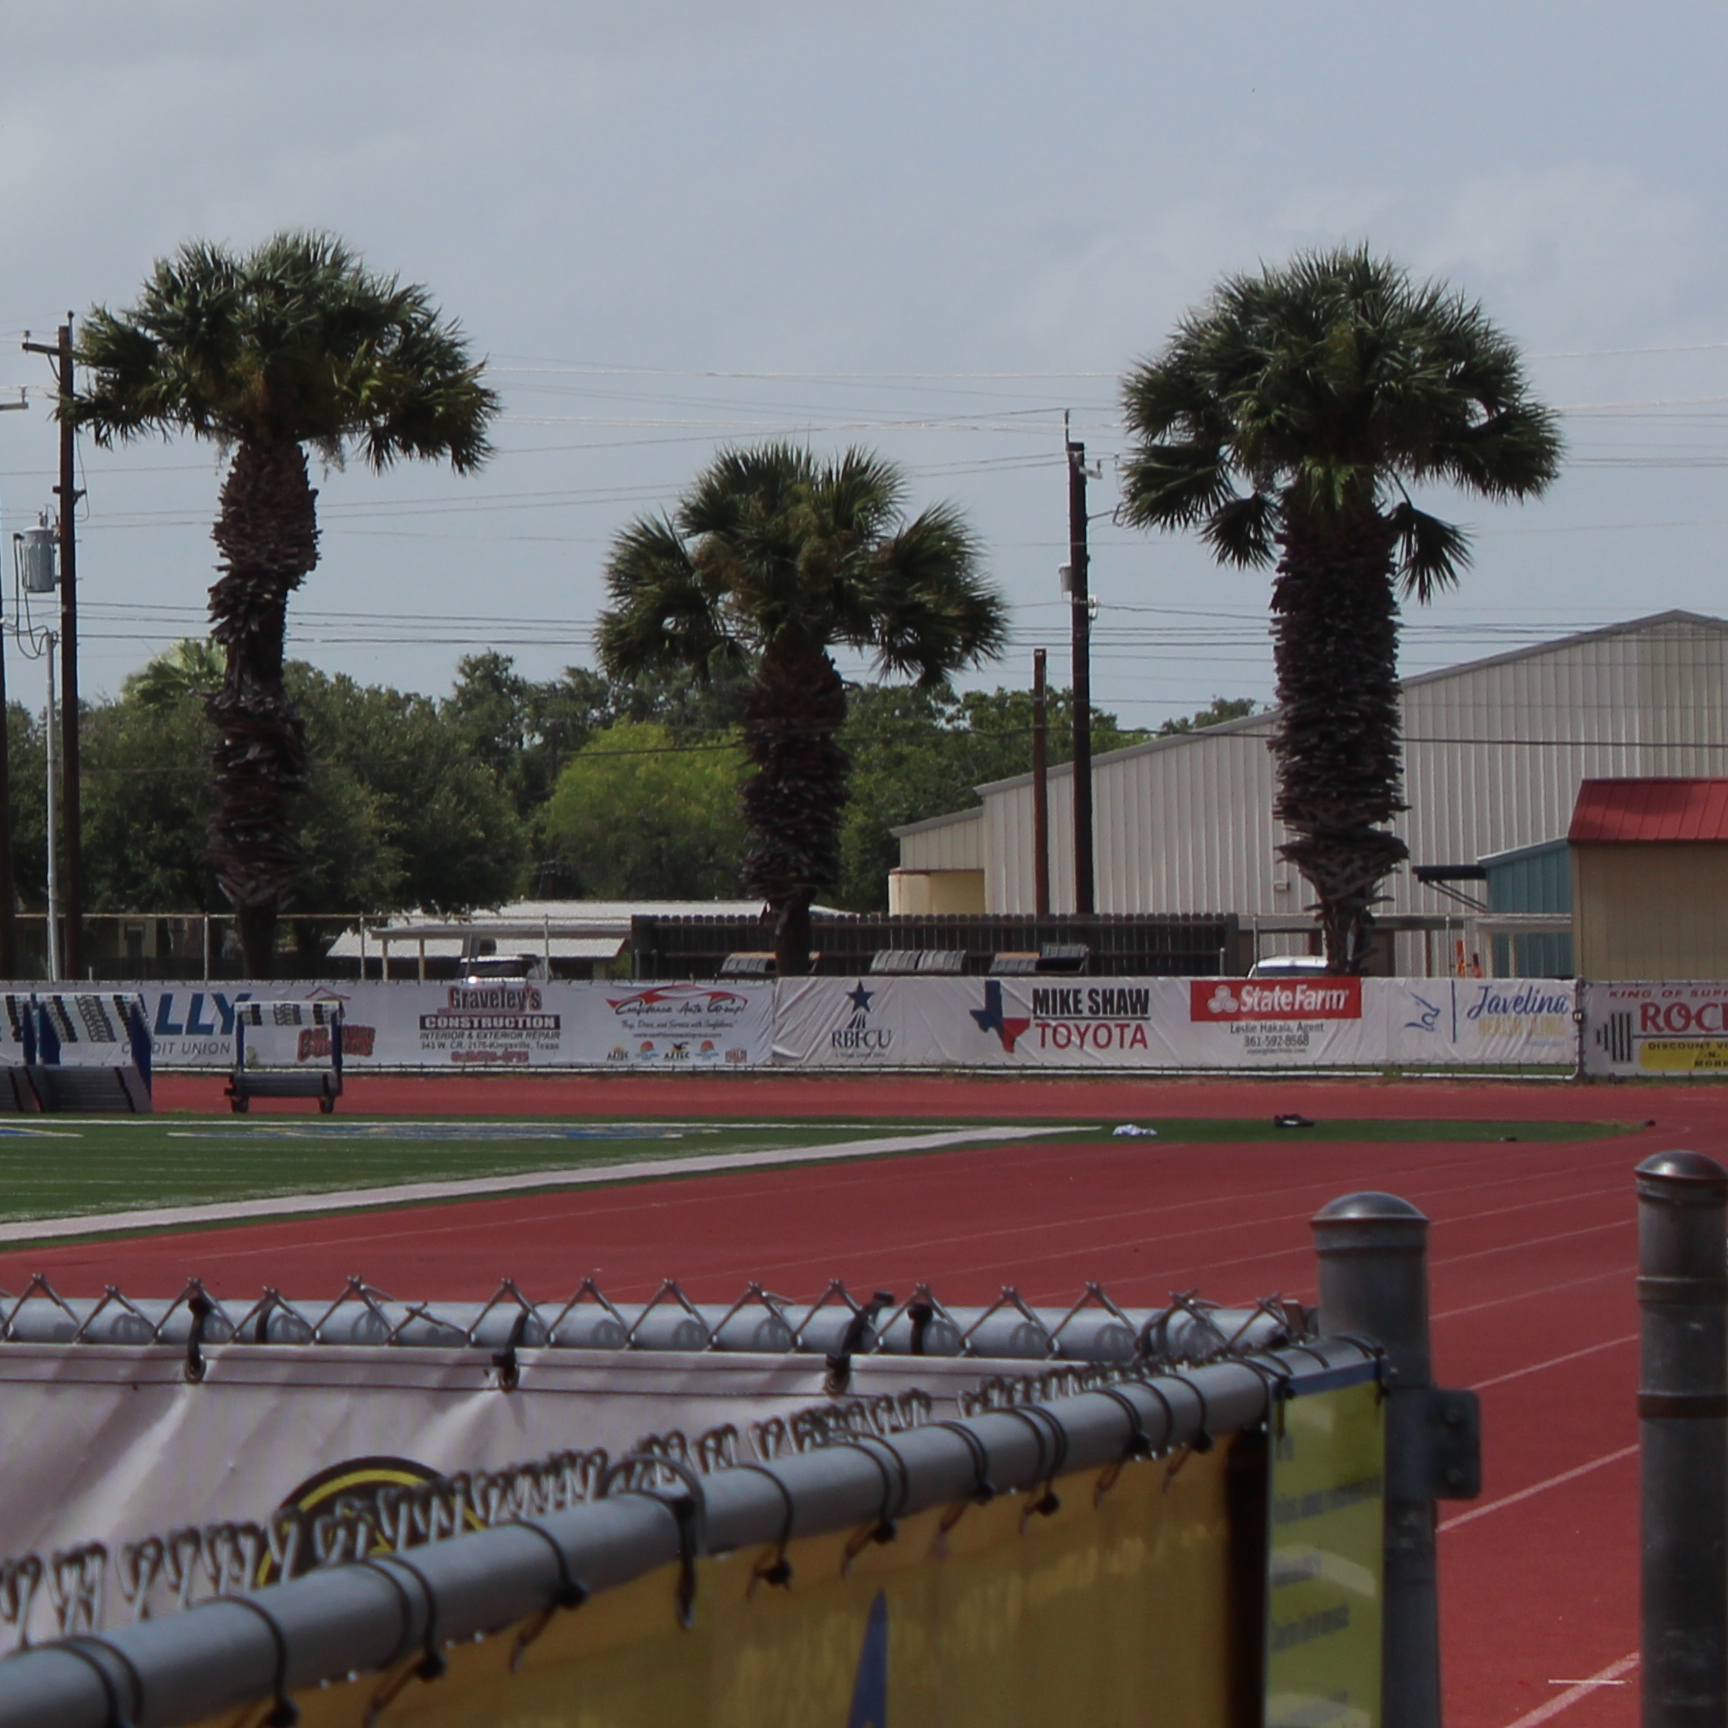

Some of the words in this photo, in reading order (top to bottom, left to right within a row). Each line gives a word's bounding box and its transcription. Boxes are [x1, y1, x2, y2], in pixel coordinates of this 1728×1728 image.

[449, 986, 542, 1011] Graveley's
[1609, 989, 1652, 999] KING
[1661, 989, 1682, 998] OF
[1032, 987, 1083, 1016] MIKE
[1087, 987, 1150, 1016] SHAW
[1466, 984, 1570, 1020] Javelina
[424, 1016, 556, 1029] CONSTRUCTION
[1296, 1021, 1324, 1035] Agent
[420, 1031, 465, 1040] INTERIOR
[476, 1031, 523, 1040] EXTERIOR
[526, 1031, 560, 1040] REPAIR
[831, 1029, 893, 1049] RBFCU
[1035, 1023, 1148, 1050] TOYOTA
[121, 1042, 176, 1056] CDIT
[181, 1042, 231, 1055] UNION
[1648, 1042, 1711, 1050] DISCOUNT
